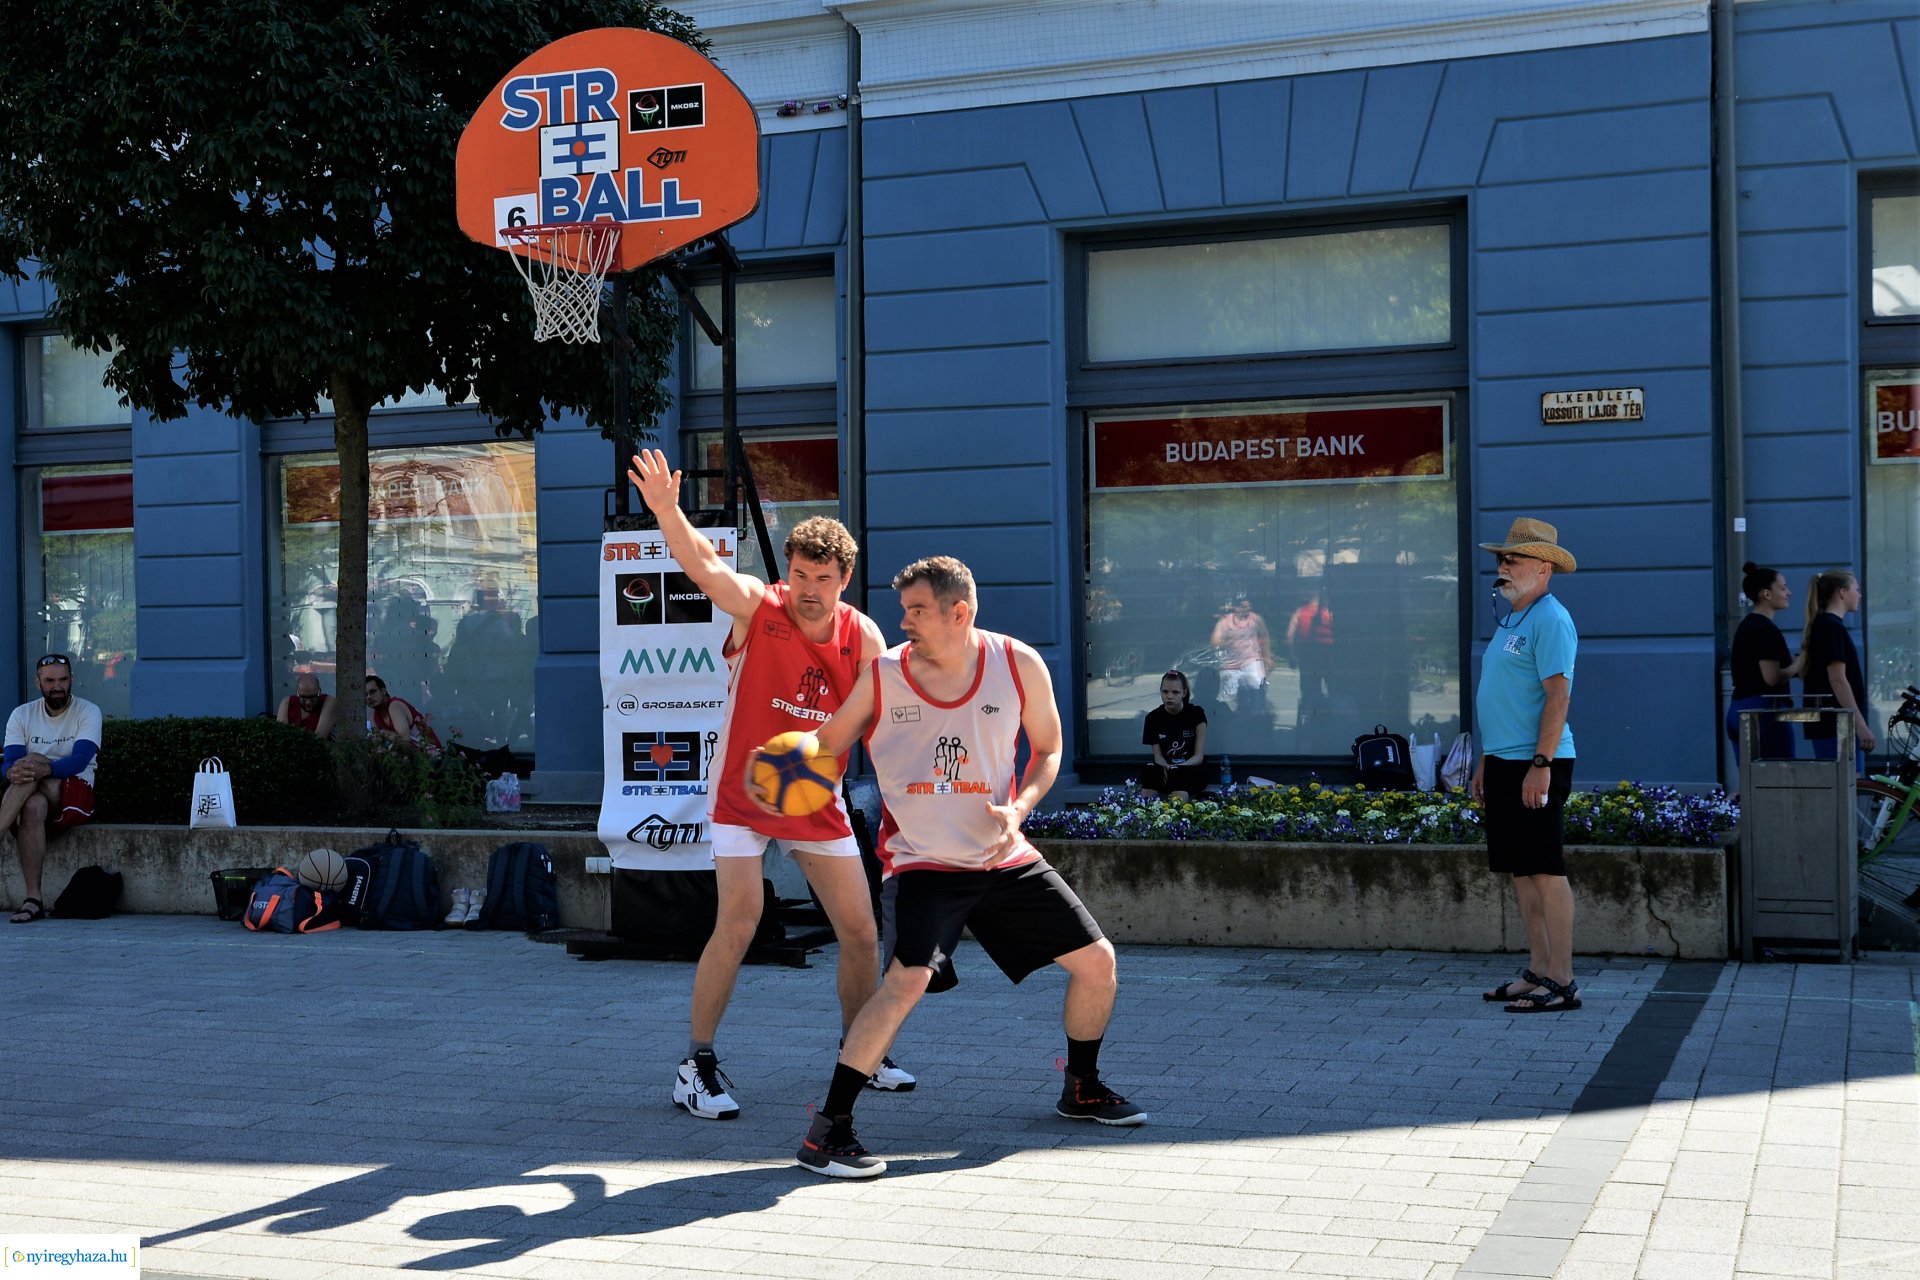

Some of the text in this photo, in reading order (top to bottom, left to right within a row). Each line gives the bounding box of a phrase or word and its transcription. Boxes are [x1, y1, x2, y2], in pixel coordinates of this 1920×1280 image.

[500, 68, 620, 131] STR
[670, 102, 699, 110] MKOSZ
[539, 168, 702, 224] BALL
[507, 206, 527, 232] 6
[1544, 405, 1583, 420] KOSSUTH
[1588, 404, 1618, 418] LAJOS
[1878, 410, 1920, 433] BU
[1165, 434, 1366, 463] BUDAPEST BANK
[669, 593, 707, 601] MKOSZ
[619, 647, 715, 674] MVM
[642, 701, 724, 709] GROSBASKET
[644, 822, 703, 845] TOTI
